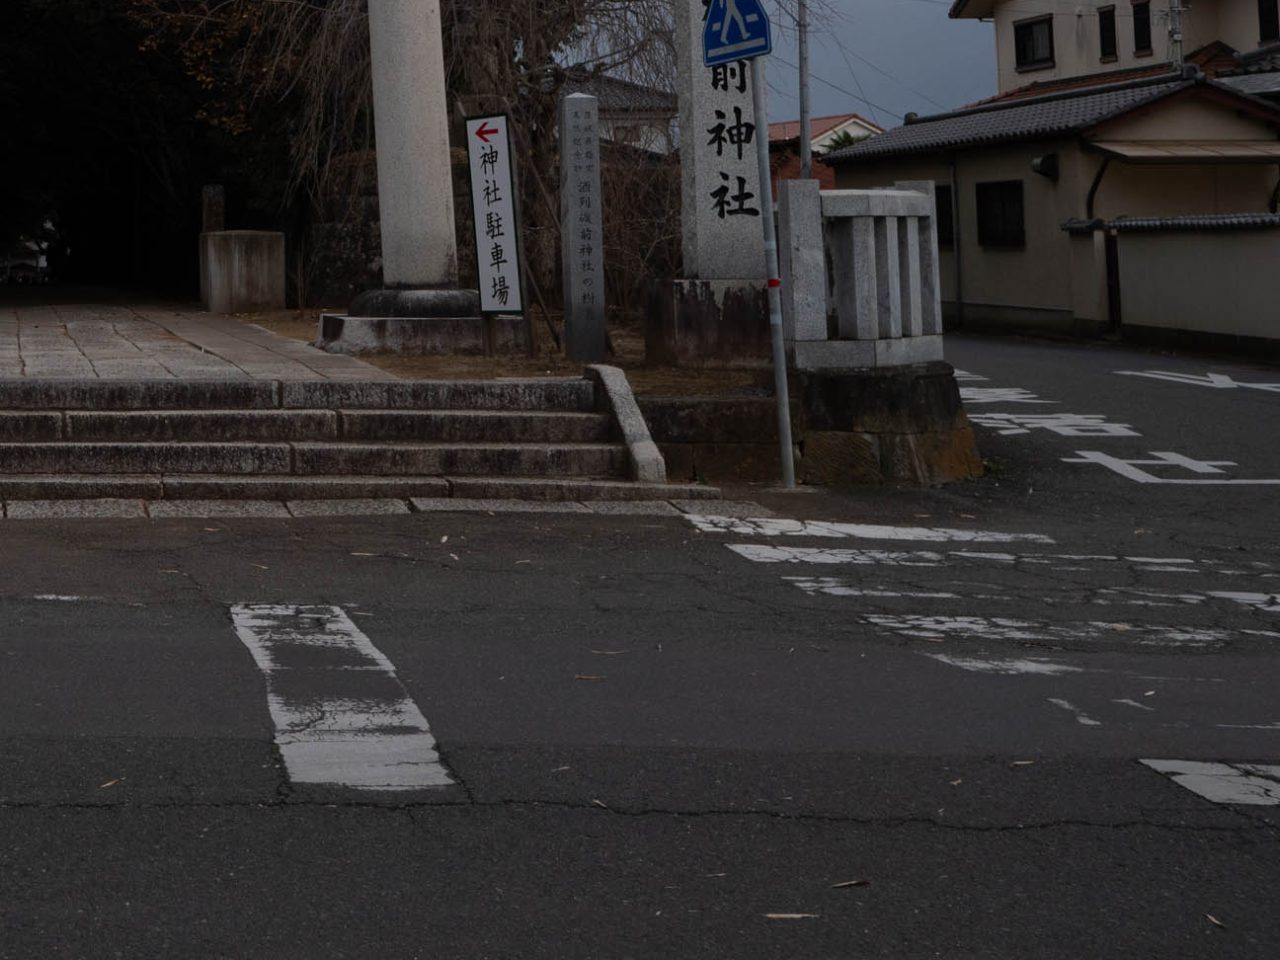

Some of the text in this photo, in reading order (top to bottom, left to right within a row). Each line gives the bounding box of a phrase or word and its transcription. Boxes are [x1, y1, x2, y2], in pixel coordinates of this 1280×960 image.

[480, 145, 510, 306] 神社駐車場
